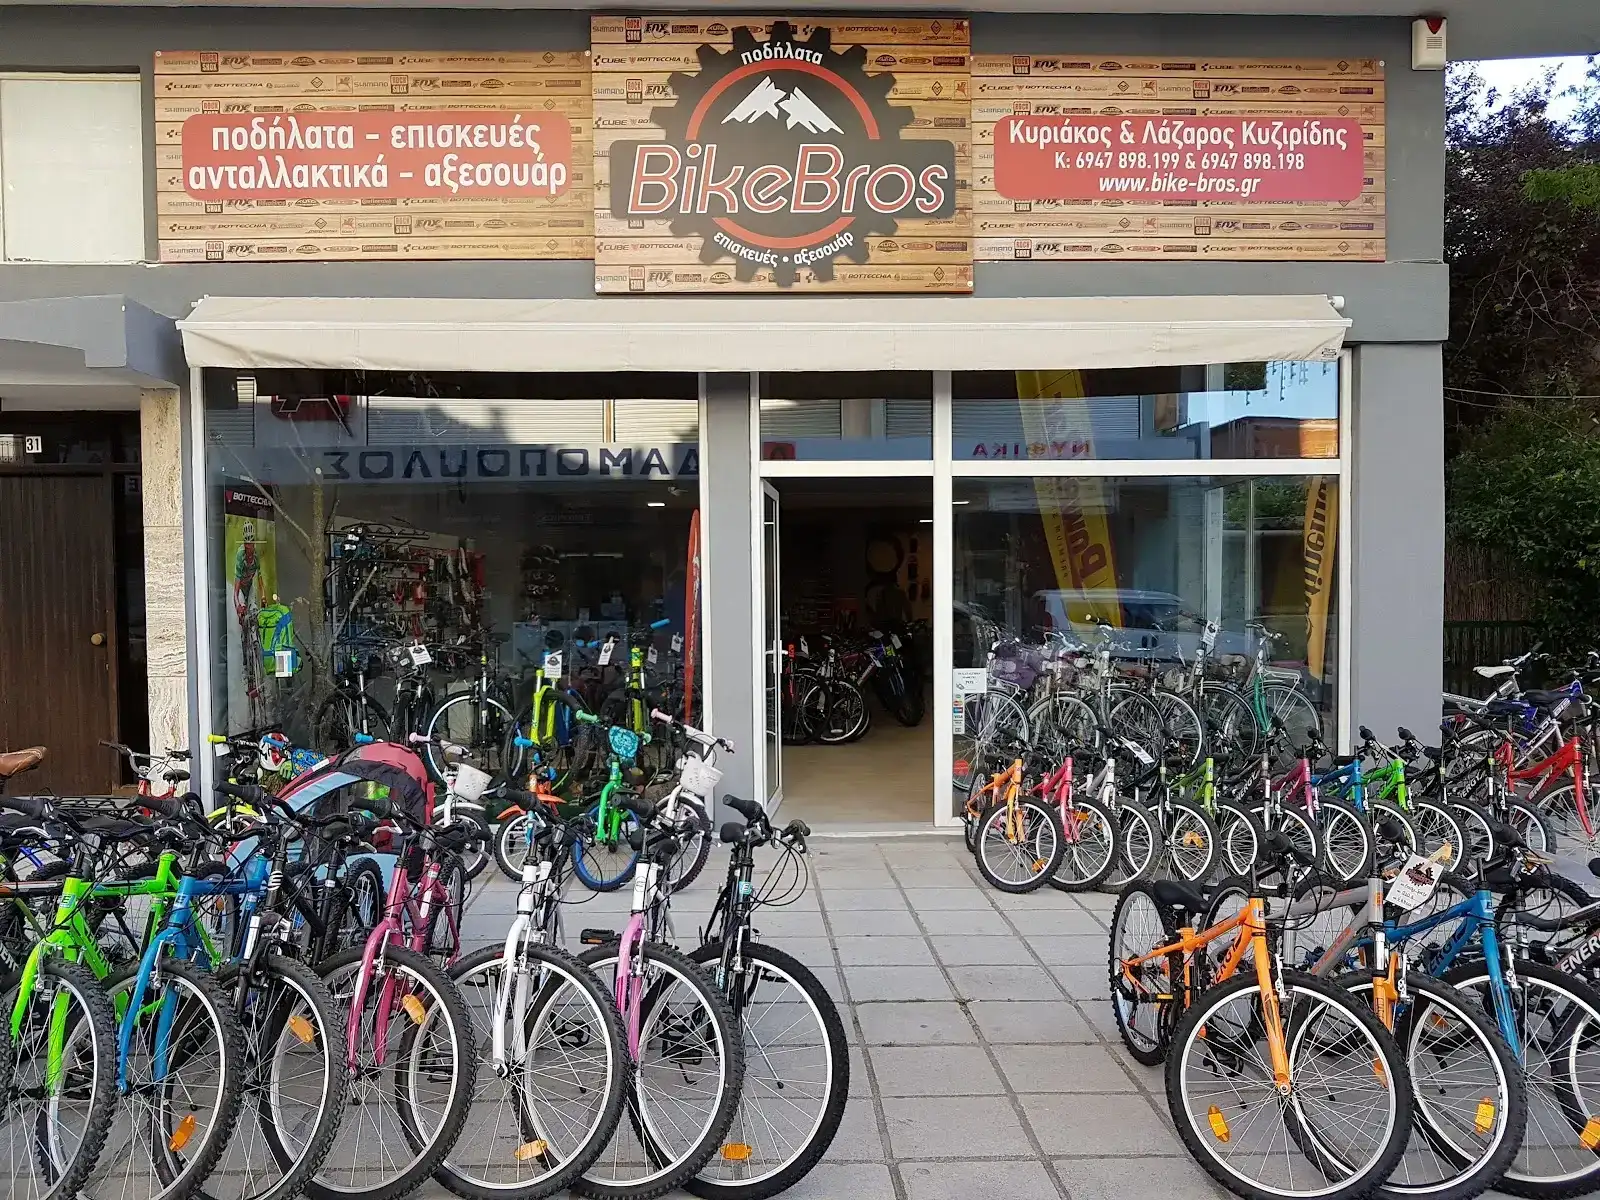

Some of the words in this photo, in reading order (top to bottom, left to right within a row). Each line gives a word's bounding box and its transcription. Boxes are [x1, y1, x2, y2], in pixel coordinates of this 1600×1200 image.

[741, 41, 823, 65] ποδήλατα
[212, 115, 354, 152] ποδήλατα
[391, 114, 541, 154] επισκευές
[1009, 119, 1112, 150] Κυριάκος
[1120, 120, 1136, 144] &
[1142, 119, 1235, 150] Λάζαρος
[1241, 119, 1348, 150] Κυζιρίδης
[188, 153, 389, 189] ανταλλακτικά
[424, 151, 567, 196] αξεσουάρ
[627, 143, 949, 214] BikeBros
[1075, 153, 1113, 170] 6947
[1118, 153, 1180, 170] 898.199
[1184, 154, 1197, 169] &
[1201, 153, 1238, 170] 6947
[1243, 153, 1305, 170] 898.198
[1098, 171, 1261, 197] www.bike-bros.gr
[714, 231, 779, 267] επισκευές
[793, 231, 854, 265] αξεσουάρ
[26, 438, 41, 452] 31
[1560, 932, 1600, 975] ENER
